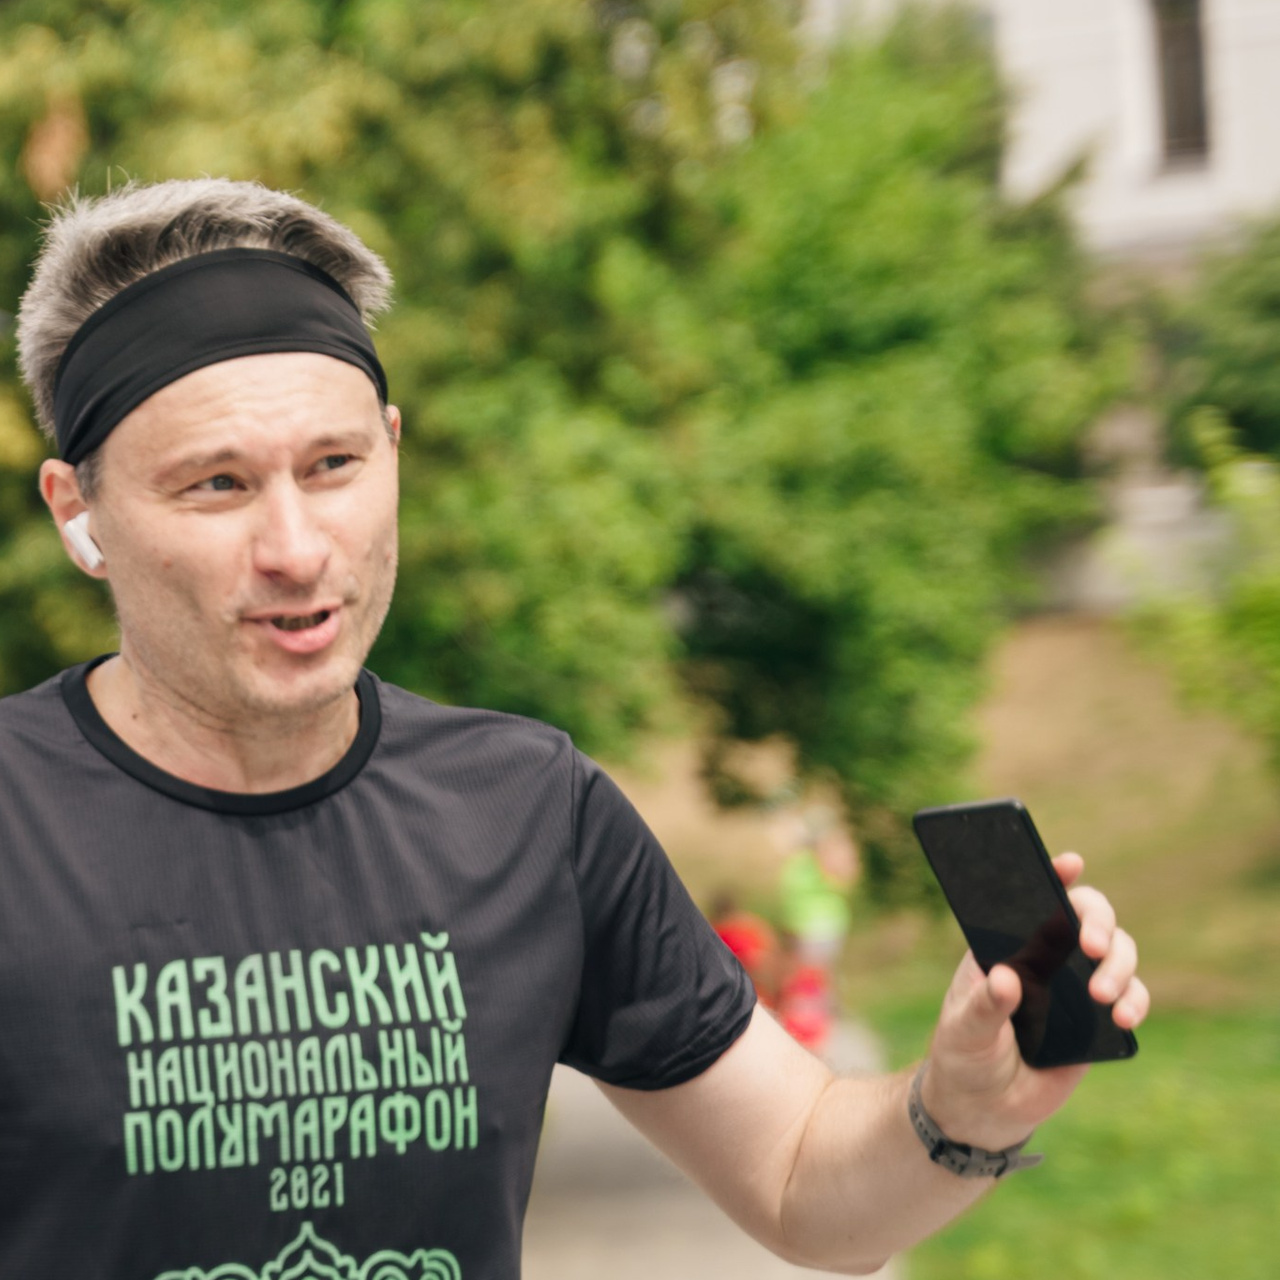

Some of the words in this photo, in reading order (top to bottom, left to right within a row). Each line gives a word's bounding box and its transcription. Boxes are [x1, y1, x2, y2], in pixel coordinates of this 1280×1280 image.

[112, 932, 467, 1046] КАЗАНСКИЙ
[127, 1018, 469, 1108] НАЦИОНАЛЬНЫЙ
[124, 1086, 478, 1175] ПОЛУМАРАФОН
[270, 1163, 344, 1211] 2021
